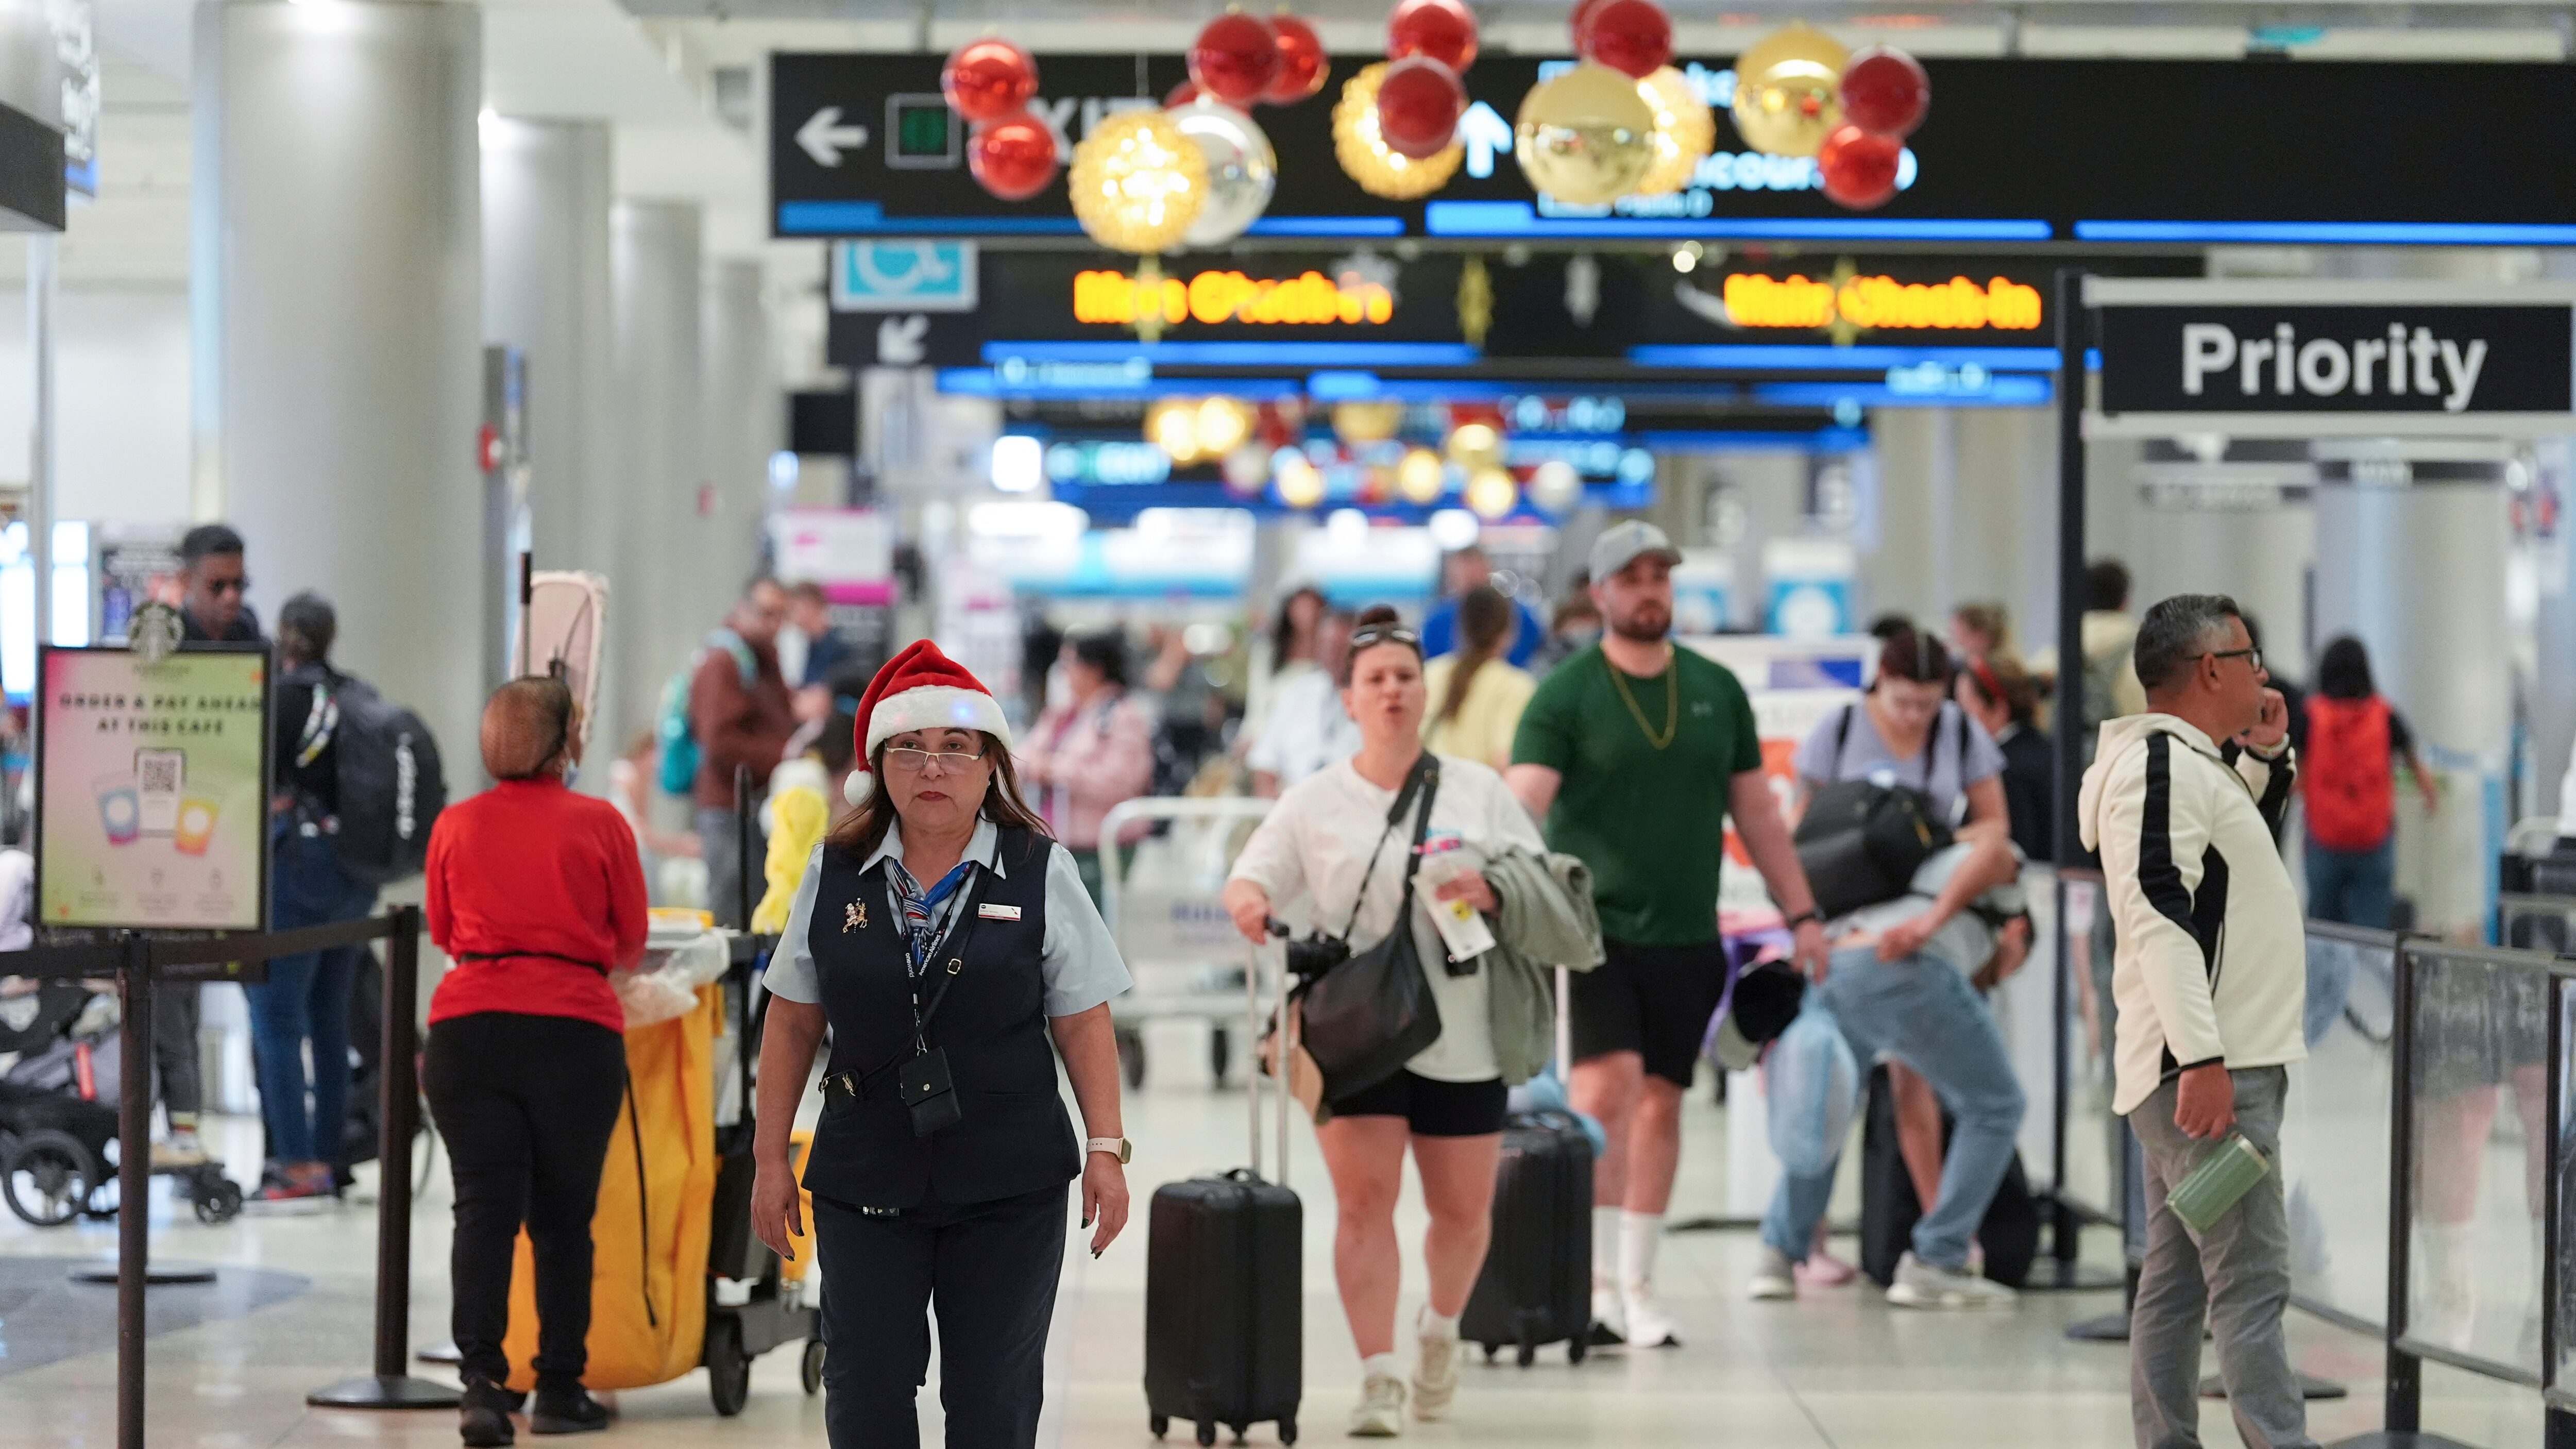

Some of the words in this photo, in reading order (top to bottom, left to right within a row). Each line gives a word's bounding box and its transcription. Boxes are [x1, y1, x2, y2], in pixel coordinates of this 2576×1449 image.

[2182, 322, 2488, 412] Priority
[154, 695, 189, 711] PAY
[96, 717, 119, 733] AT
[128, 717, 170, 735] THIS
[905, 952, 914, 978] oneworld
[919, 952, 933, 976] American
[929, 934, 941, 953] Airlines
